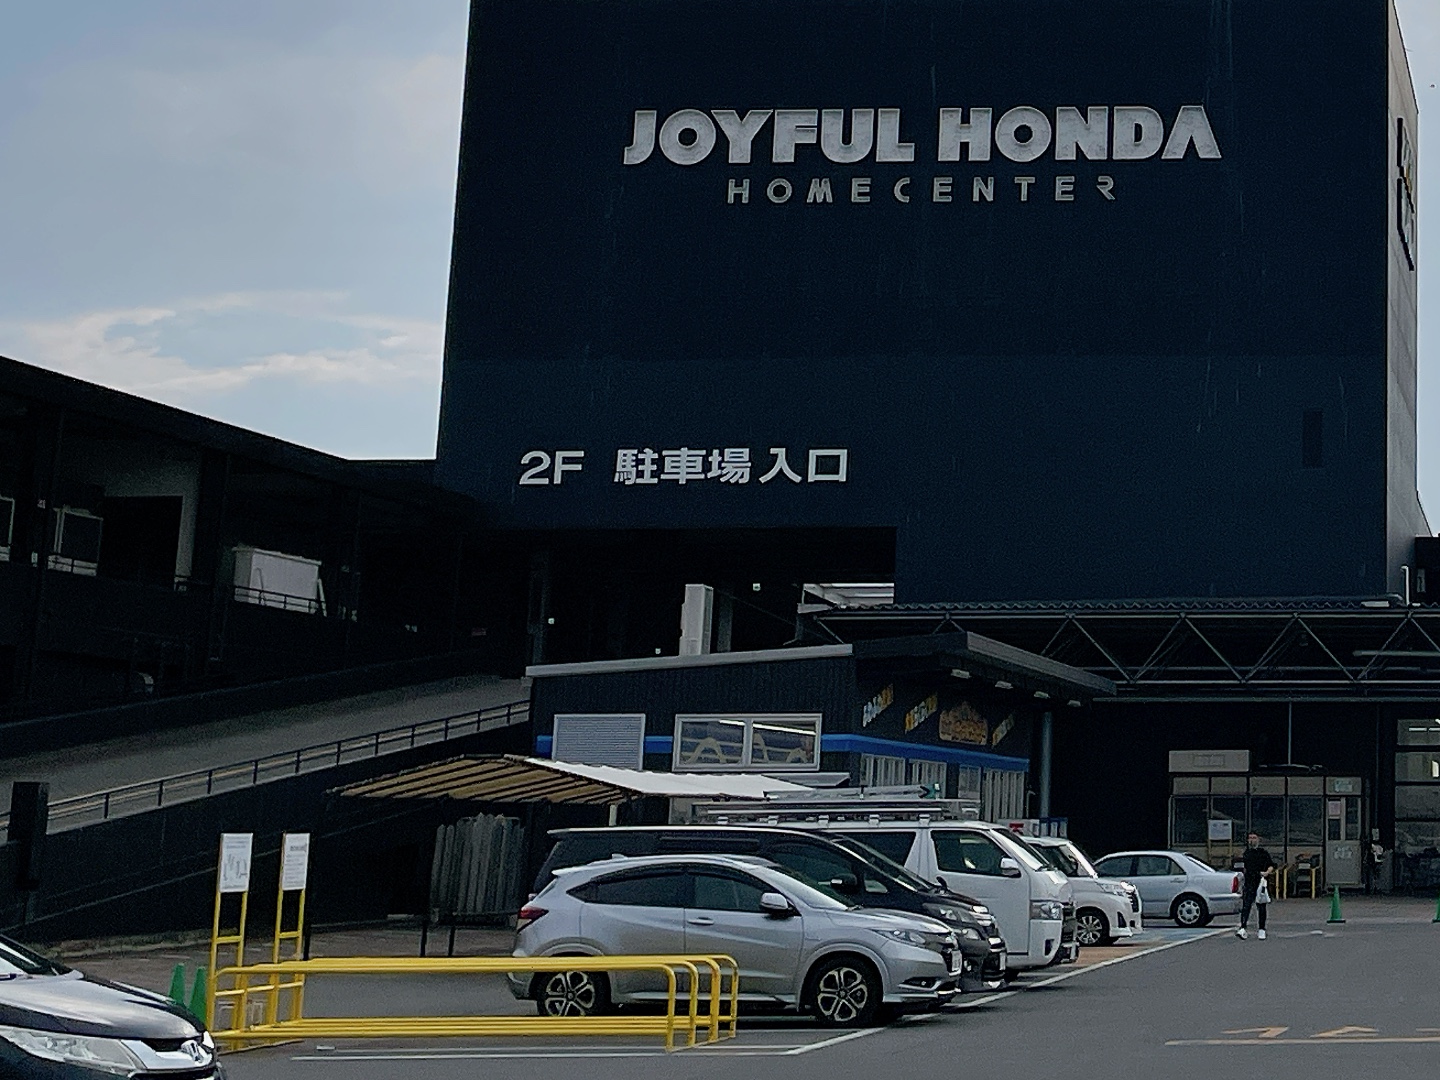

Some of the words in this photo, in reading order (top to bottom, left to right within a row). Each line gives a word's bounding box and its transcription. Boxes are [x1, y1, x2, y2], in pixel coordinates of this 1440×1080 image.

[623, 108, 915, 165] JOYFUL
[938, 105, 1222, 162] HONDA
[519, 450, 585, 484] 2F
[614, 447, 849, 484] 駐車場入口
